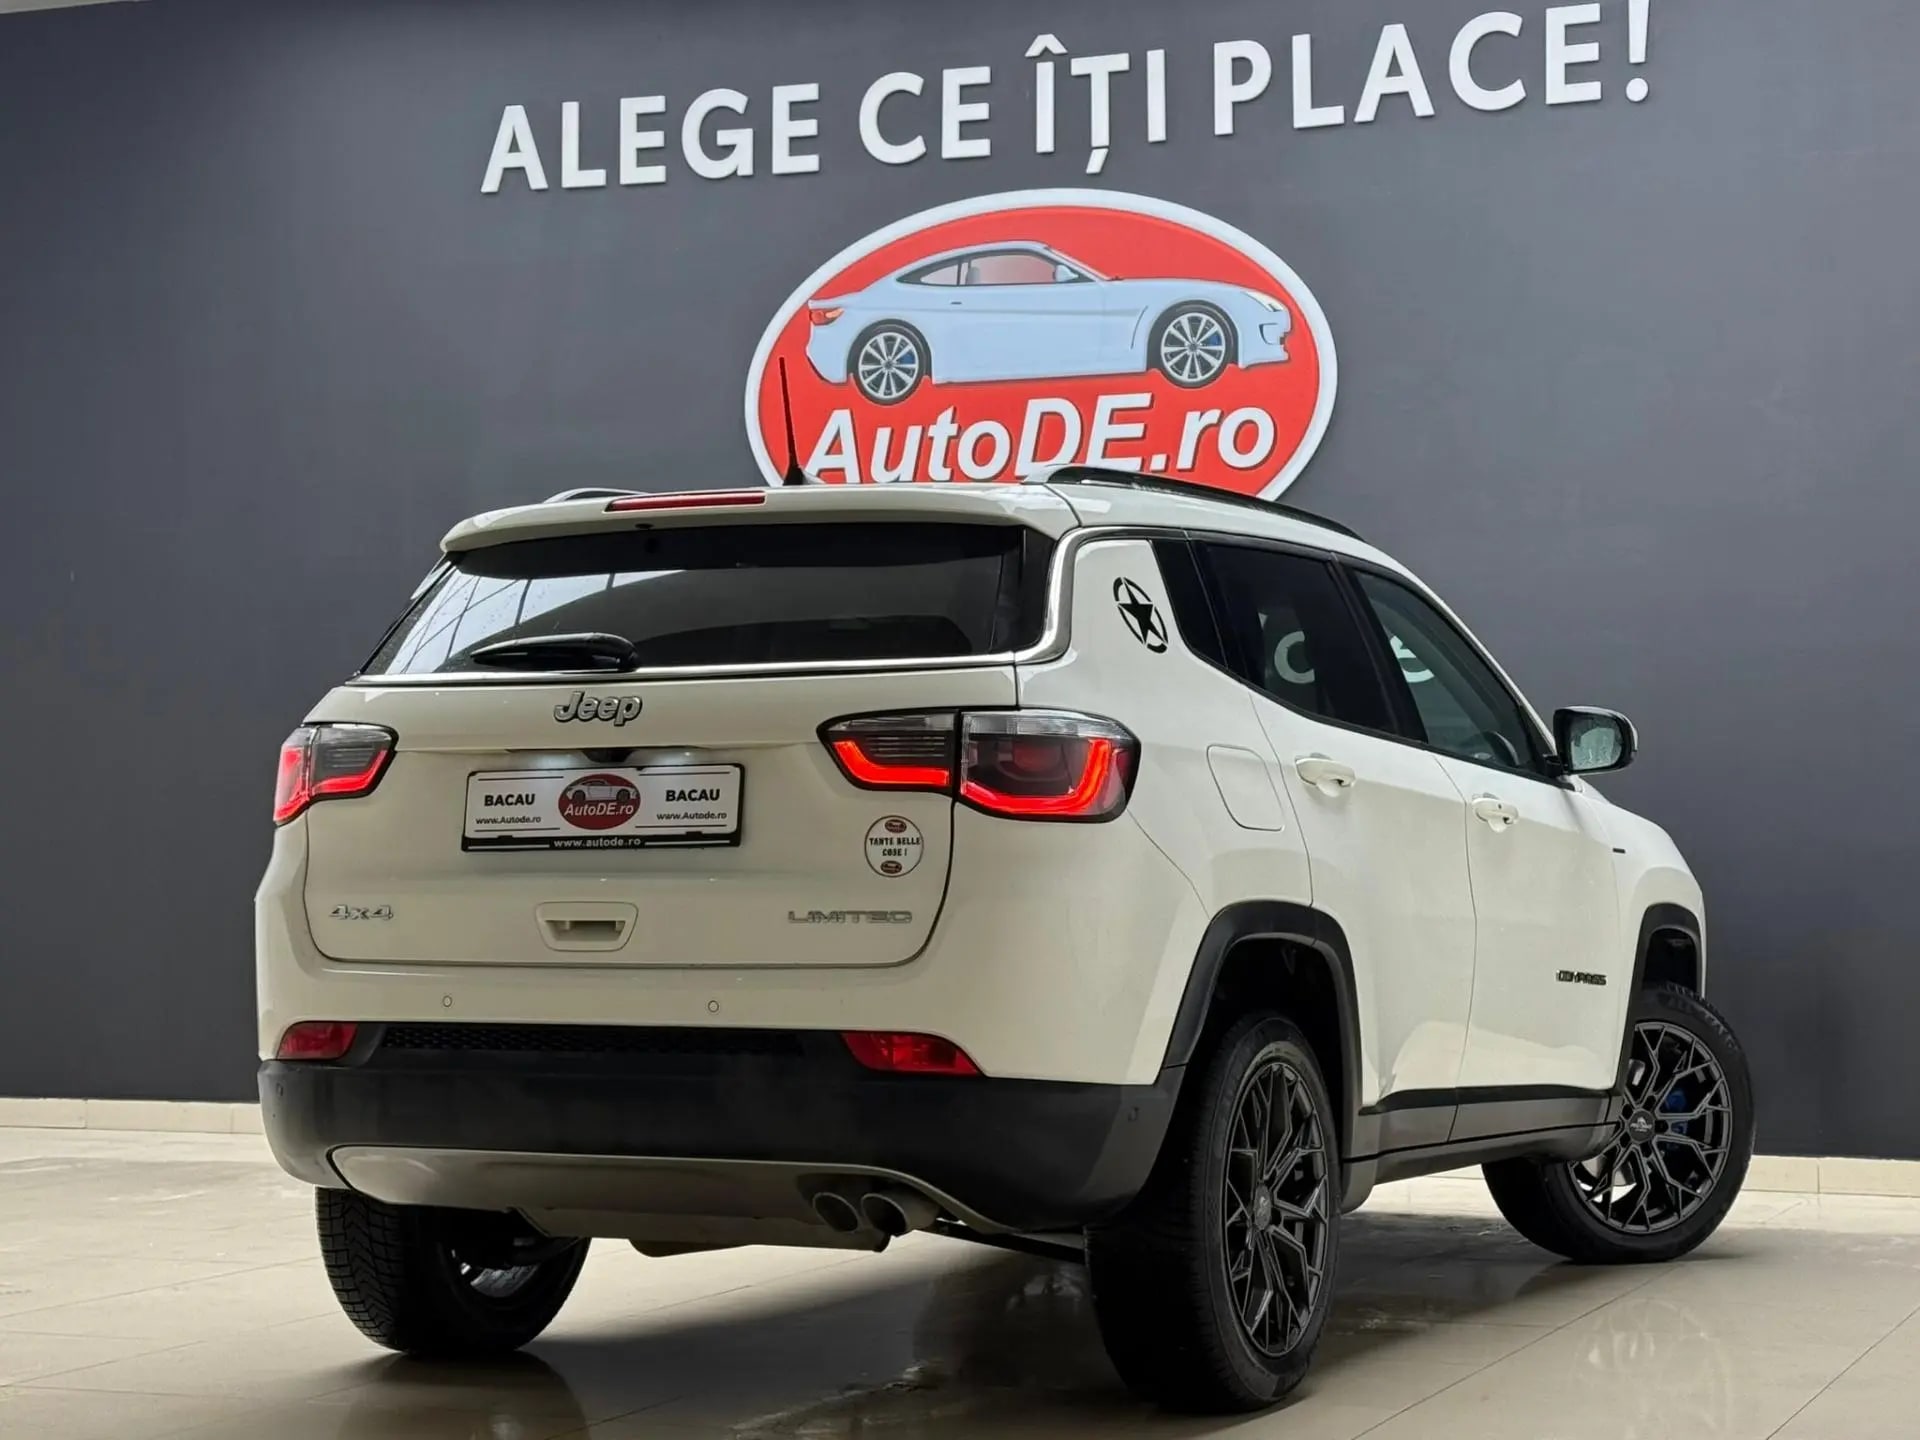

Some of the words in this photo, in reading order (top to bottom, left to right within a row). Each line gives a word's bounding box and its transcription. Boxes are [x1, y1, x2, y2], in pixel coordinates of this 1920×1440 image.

[480, 82, 820, 193] ALEGE
[858, 65, 992, 164] CE
[1213, 0, 1651, 137] PLACE!
[805, 392, 1275, 484] AutoDE.ro
[554, 690, 643, 727] Jeep
[484, 794, 536, 806] BACAU
[665, 789, 720, 802] BACAU
[564, 802, 635, 817] AutoDE.ro
[656, 811, 728, 821] www.Autode.ro
[475, 815, 542, 825] www.Autode.ro
[553, 837, 642, 848] www.autode.ro
[869, 837, 894, 846] TANTE
[897, 837, 921, 846] BELLE
[882, 848, 902, 857] COSE
[329, 904, 394, 920] 4x4
[788, 910, 913, 924] LIMITED
